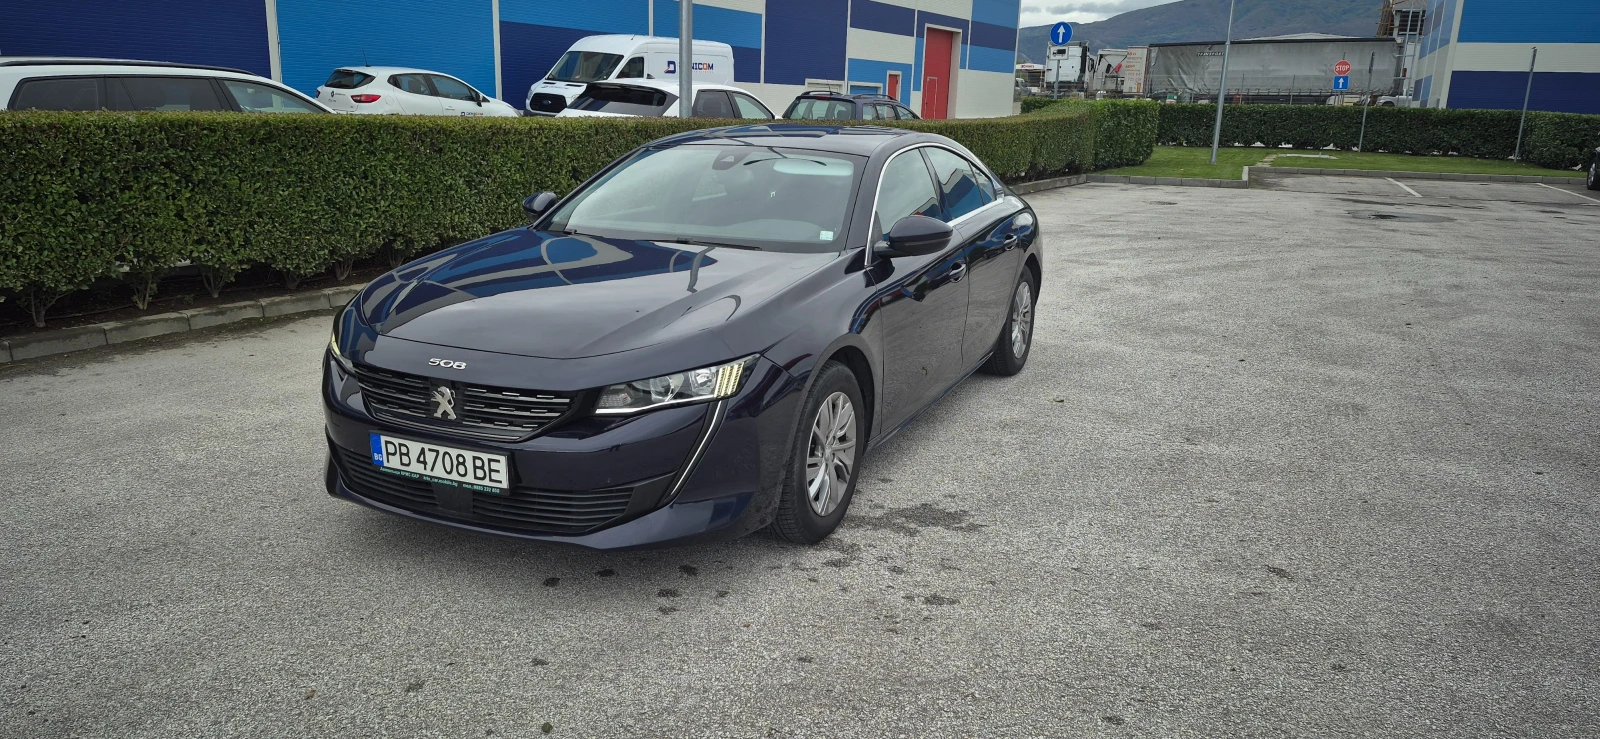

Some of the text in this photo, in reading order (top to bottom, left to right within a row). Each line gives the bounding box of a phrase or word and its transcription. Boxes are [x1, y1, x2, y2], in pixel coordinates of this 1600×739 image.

[429, 358, 467, 370] 508
[374, 452, 383, 461] BG
[384, 440, 503, 484] PB 4708 BE
